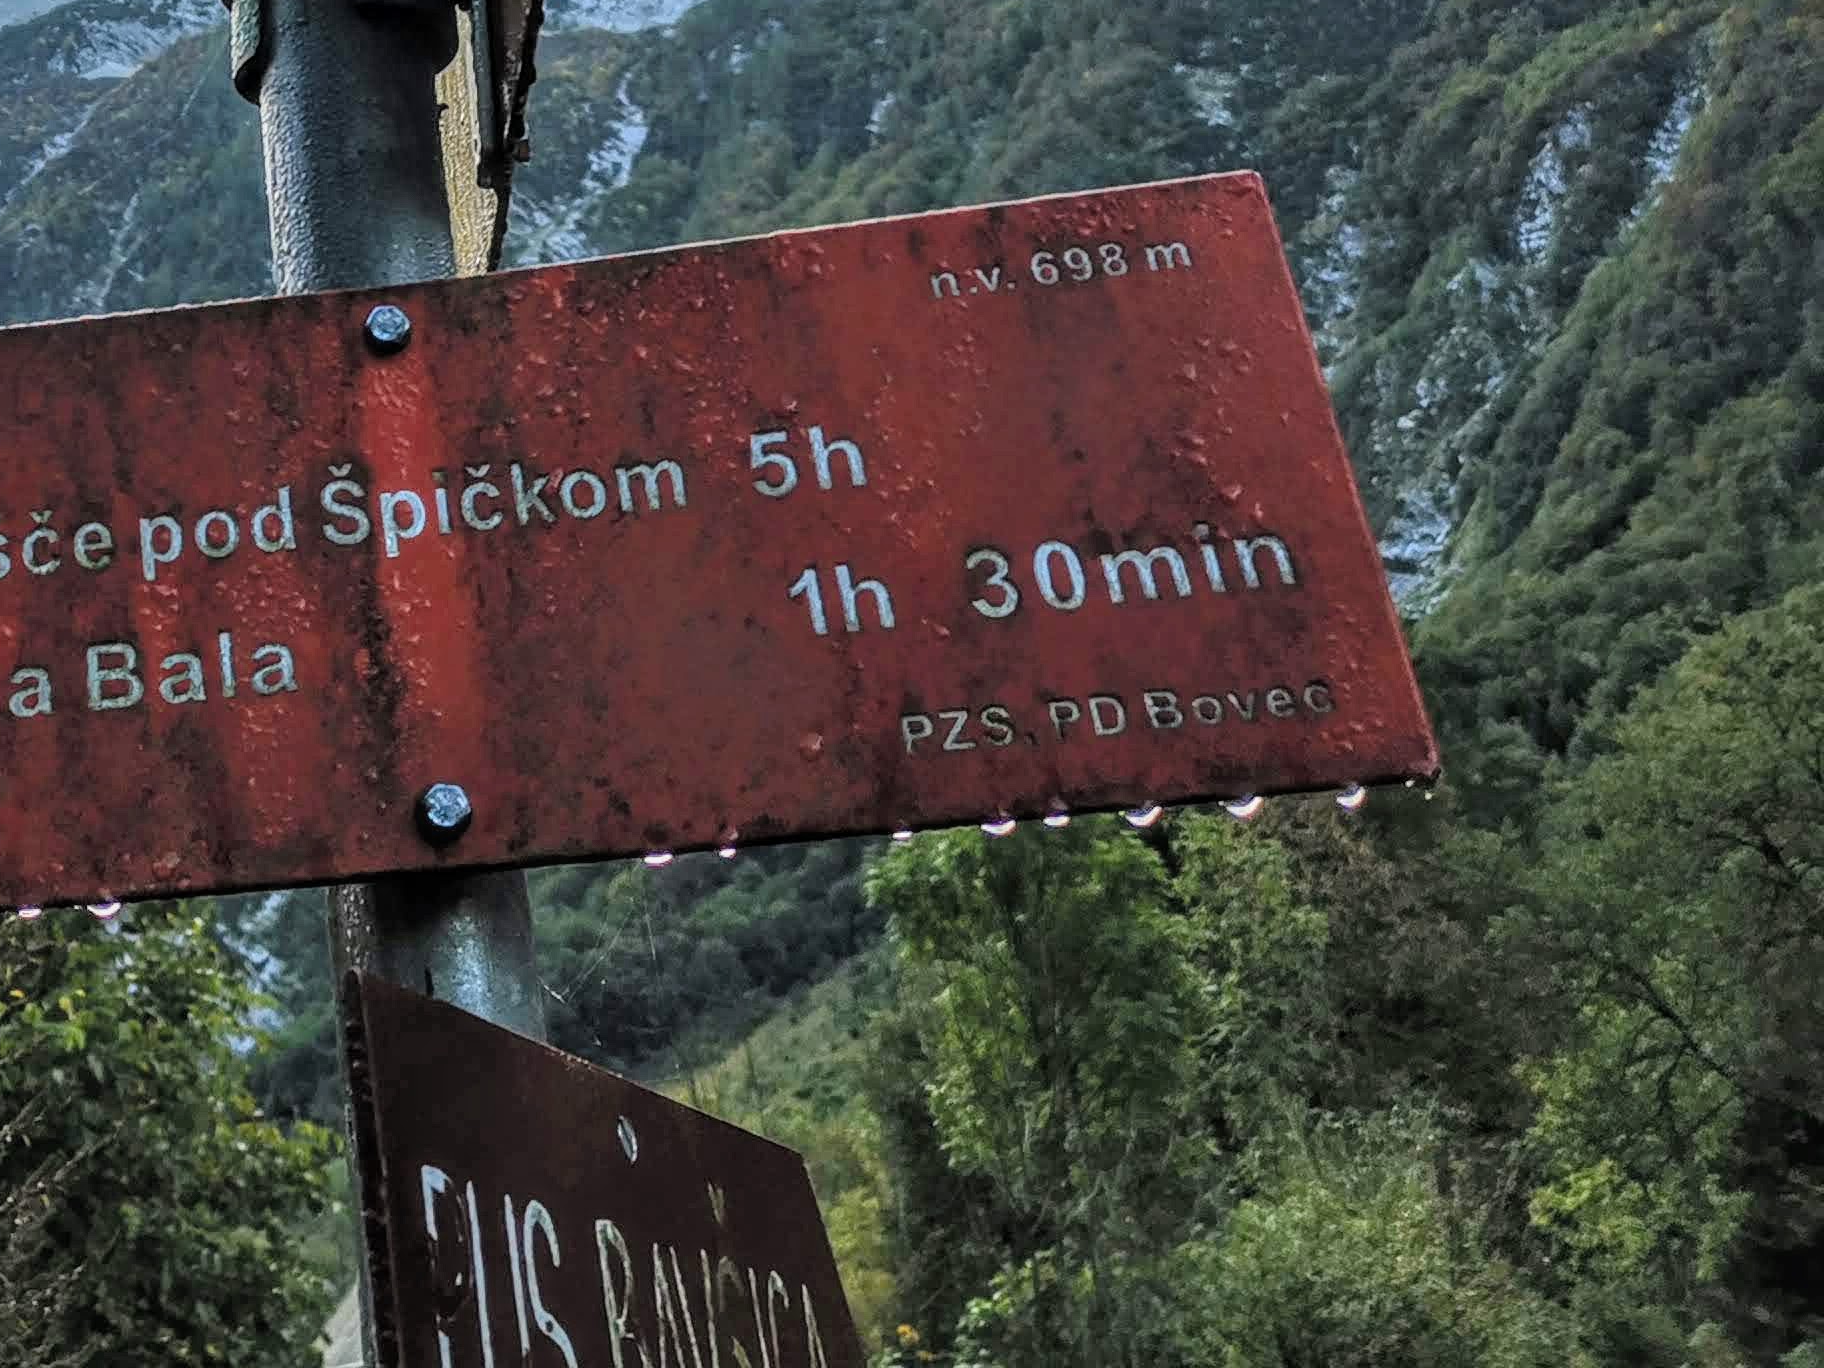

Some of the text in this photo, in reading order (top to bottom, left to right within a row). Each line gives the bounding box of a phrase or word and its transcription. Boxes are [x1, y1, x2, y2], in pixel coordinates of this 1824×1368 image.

[929, 242, 1192, 299] n.v. 698 m
[139, 484, 297, 581] pod
[320, 460, 687, 558] Špičkom
[749, 426, 868, 497] 5h
[86, 632, 298, 711] Bala
[788, 564, 895, 635] 1h
[966, 524, 1296, 618] 30min
[1048, 696, 1127, 741] PD
[1143, 681, 1337, 730] Bovec
